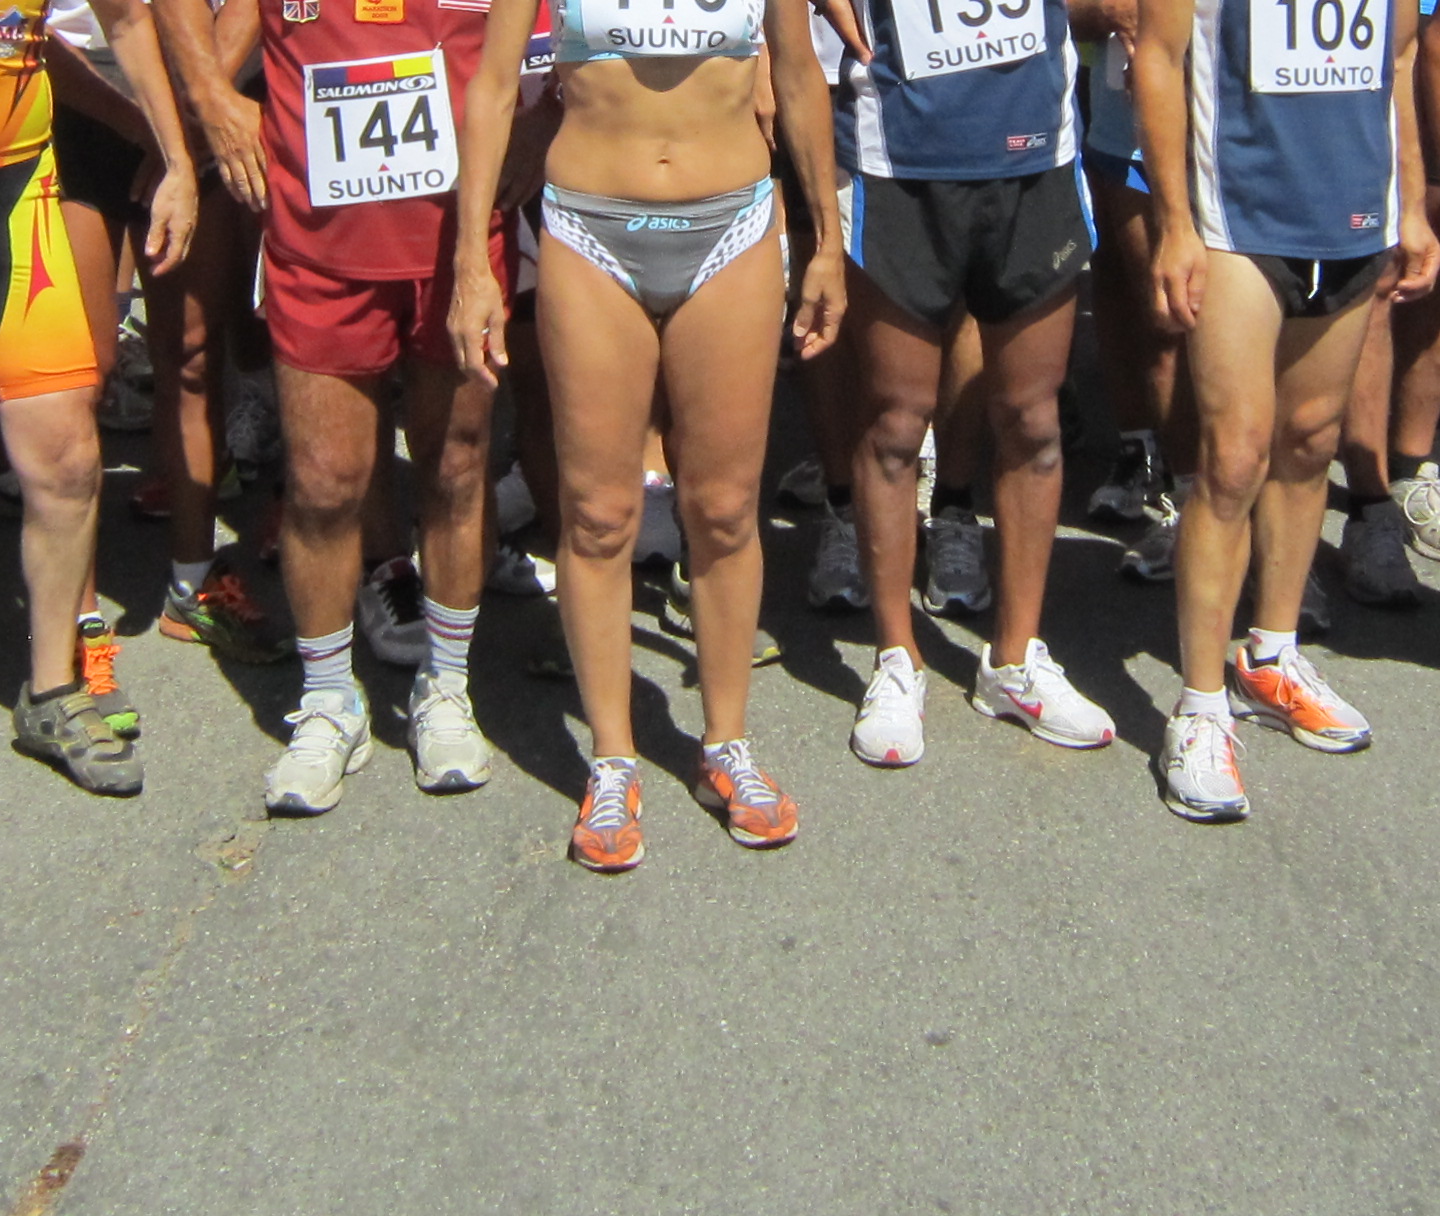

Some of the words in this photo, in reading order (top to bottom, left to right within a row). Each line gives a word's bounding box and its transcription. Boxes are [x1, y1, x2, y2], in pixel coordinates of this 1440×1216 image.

[607, 27, 727, 49] SUUNTO
[926, 32, 1037, 70] SUUNTO
[1275, 66, 1374, 86] SUUNTO
[317, 80, 398, 99] SALOMON
[324, 95, 439, 162] 144
[328, 169, 445, 199] SUUNTO
[648, 216, 691, 230] asics
